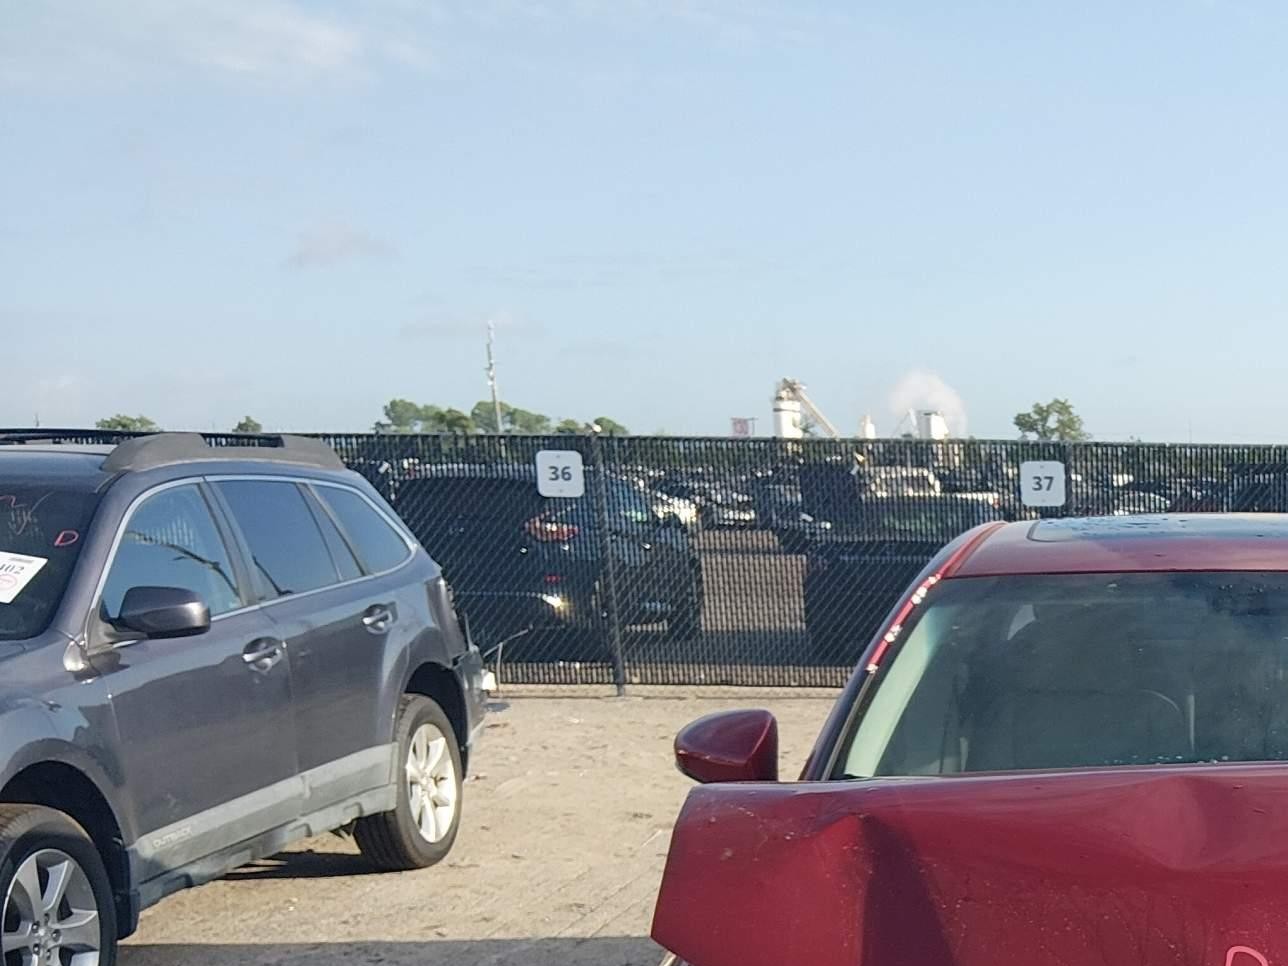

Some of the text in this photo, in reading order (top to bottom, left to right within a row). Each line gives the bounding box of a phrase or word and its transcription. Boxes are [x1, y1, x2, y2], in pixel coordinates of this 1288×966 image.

[548, 465, 572, 481] 36
[1031, 475, 1055, 492] 37
[53, 529, 80, 547] D
